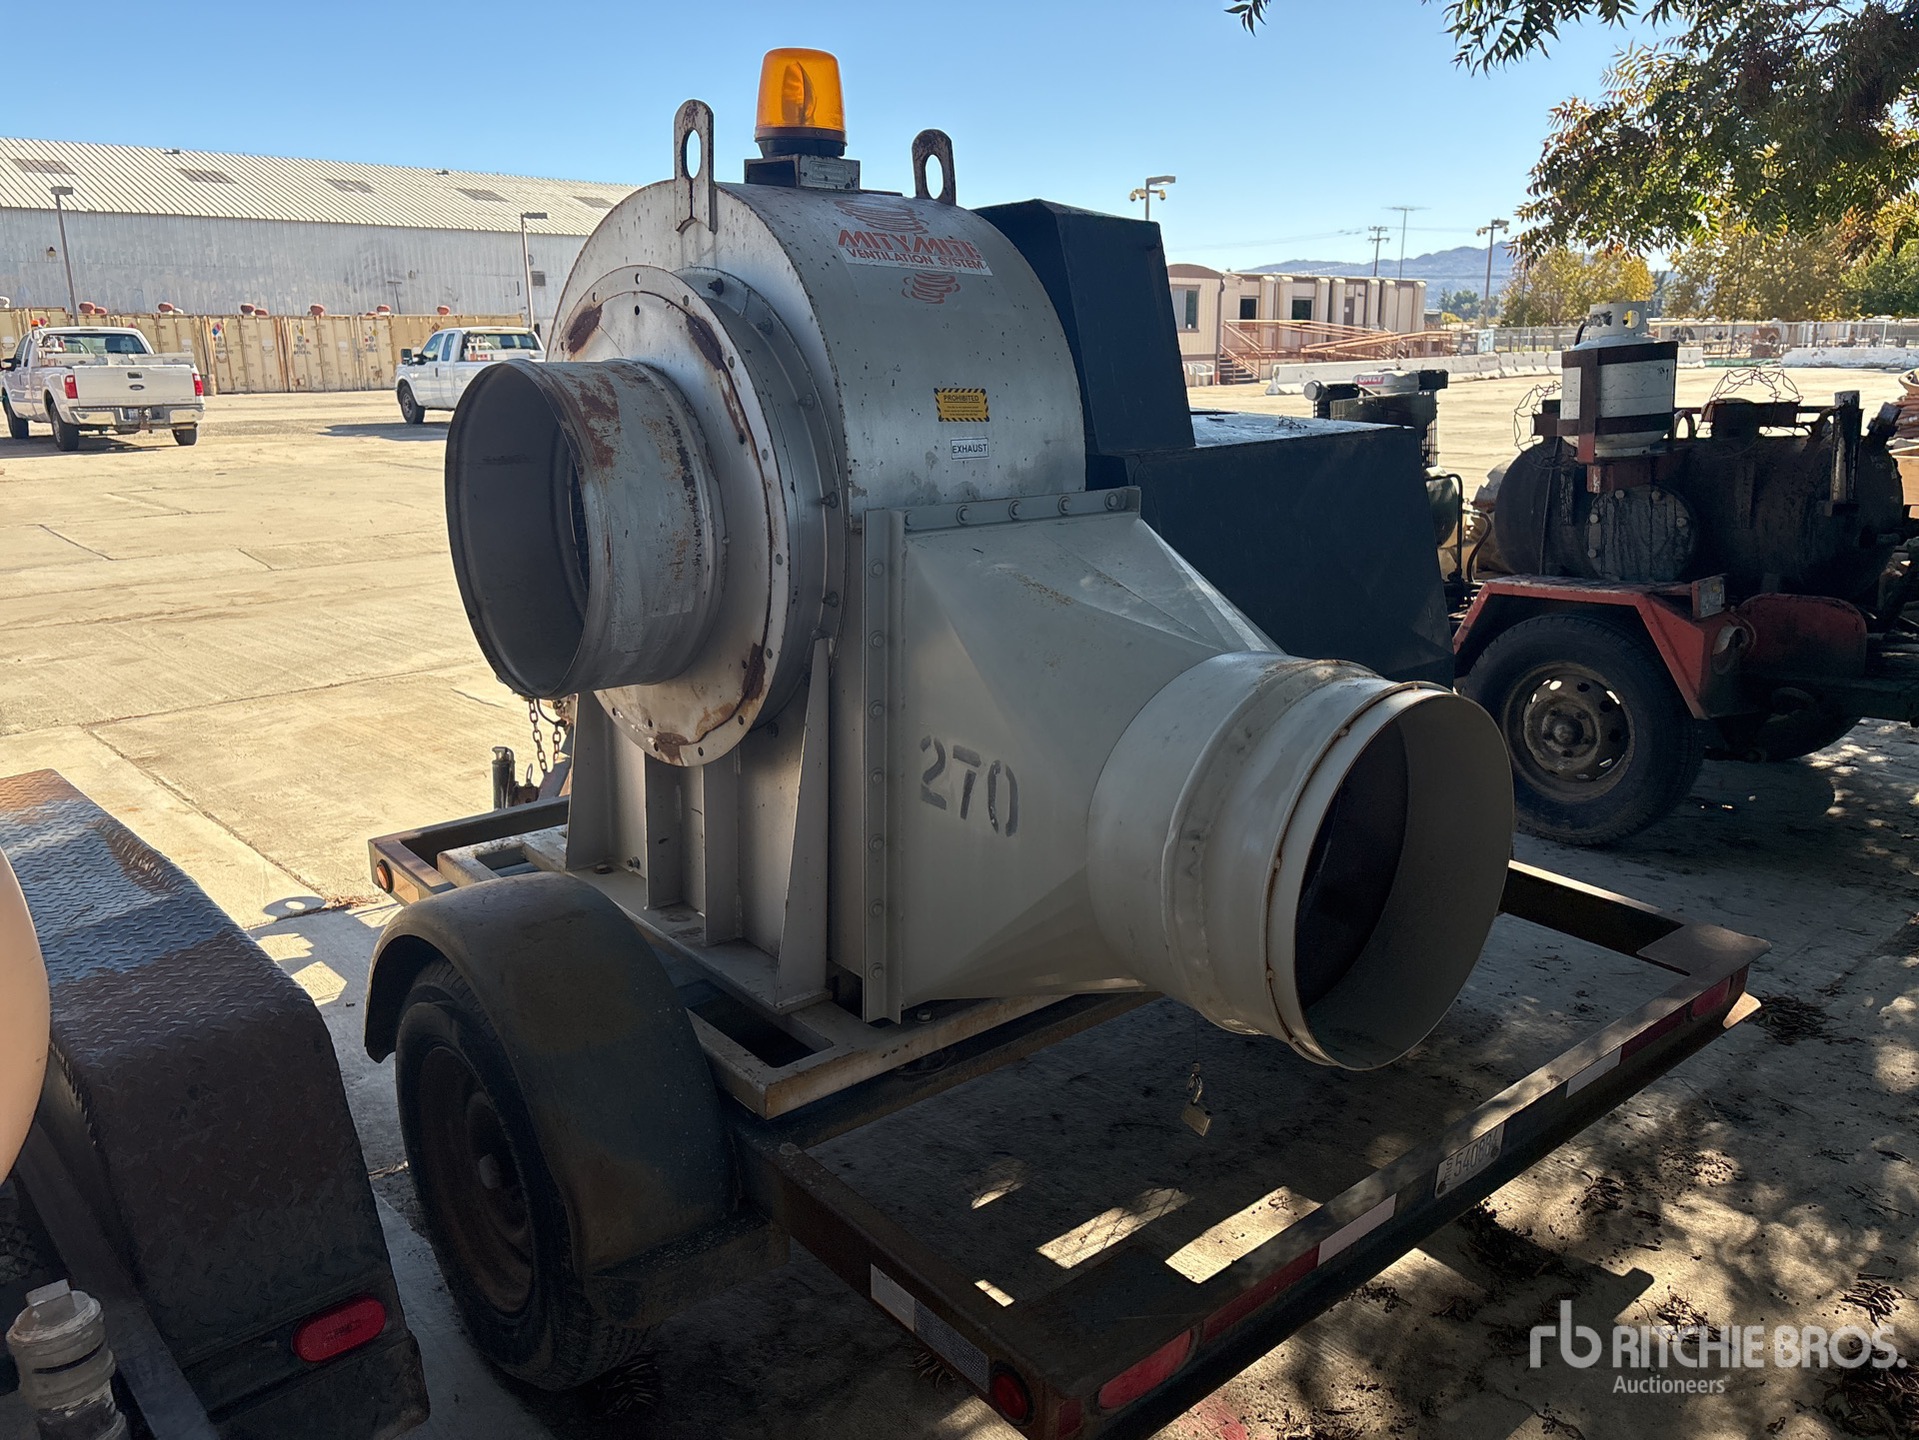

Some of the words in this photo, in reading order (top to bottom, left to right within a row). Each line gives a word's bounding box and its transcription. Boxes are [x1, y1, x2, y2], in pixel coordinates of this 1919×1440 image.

[845, 248, 934, 265] VENTILATION
[937, 256, 985, 270] SYSTEM
[943, 394, 980, 402] PROHIBITED
[952, 443, 988, 454] EXHAUST
[920, 735, 1019, 837] 270
